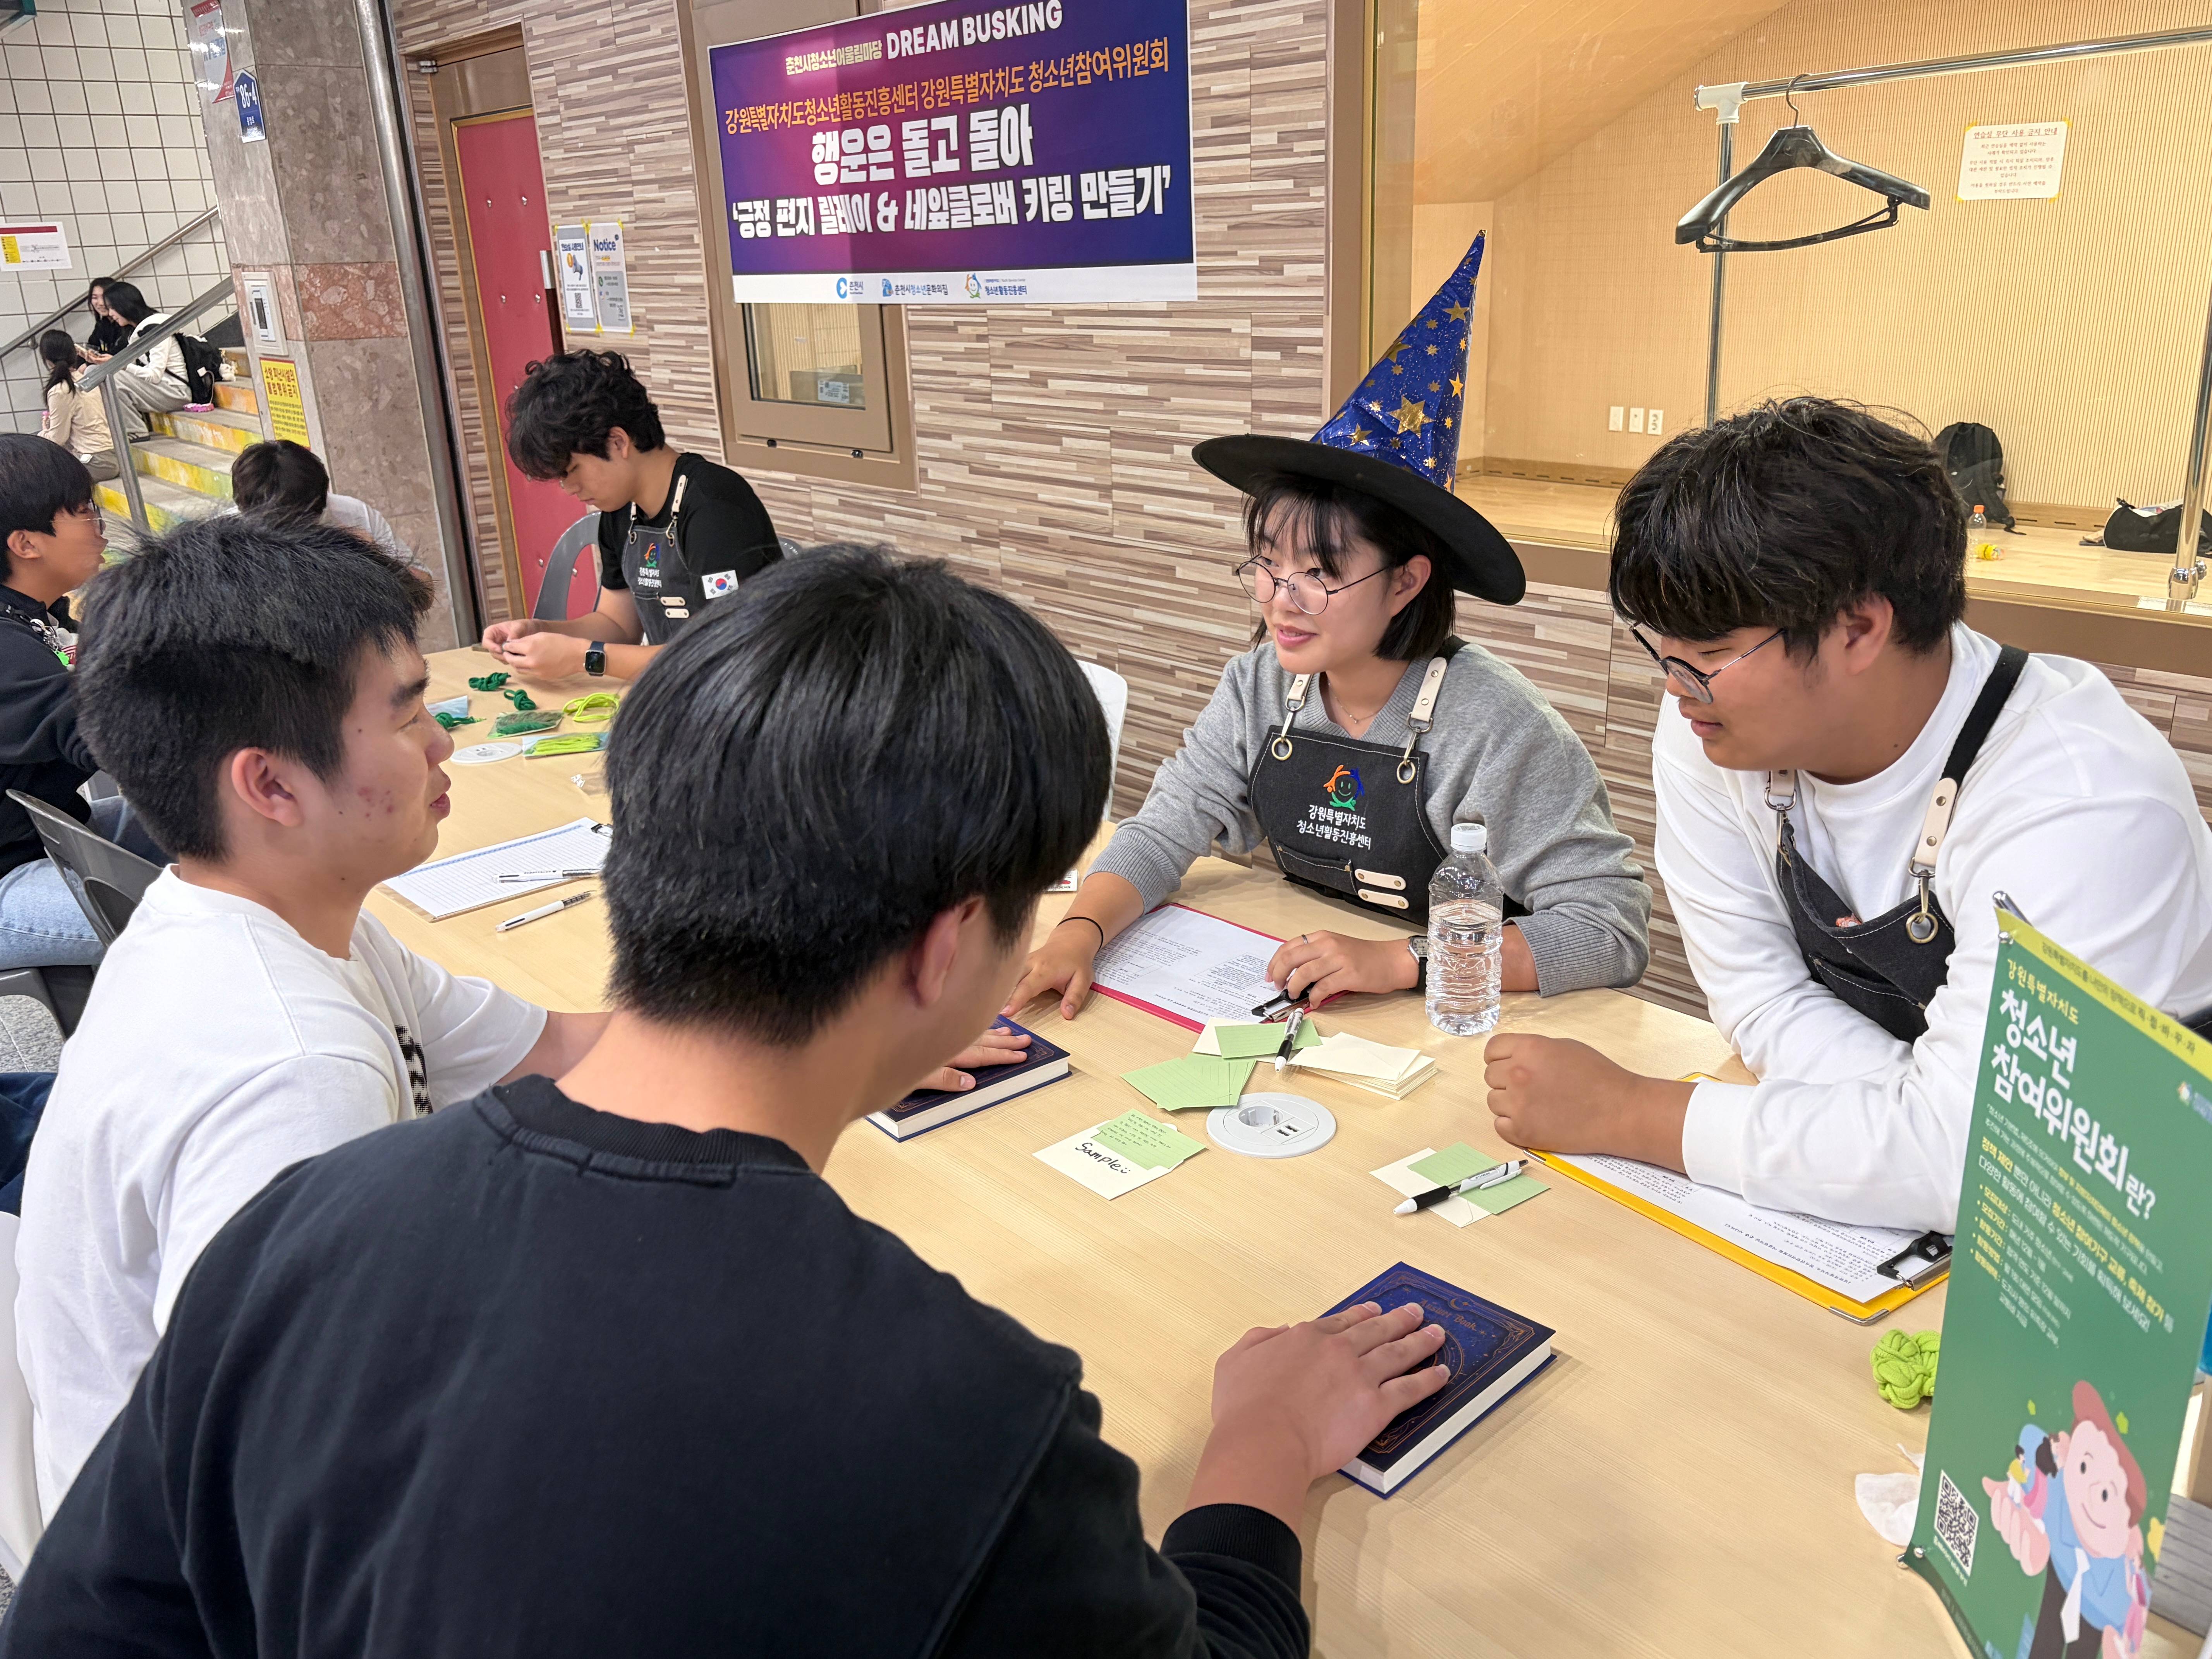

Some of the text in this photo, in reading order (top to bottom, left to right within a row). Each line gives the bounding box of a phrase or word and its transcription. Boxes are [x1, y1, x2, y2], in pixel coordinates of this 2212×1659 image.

[886, 19, 959, 59] DREAM
[963, 0, 1063, 46] BUSKING
[725, 37, 1169, 135] 강원특별자치도청소년활동진흥센터 강원특별자치도 청소년참여위원회
[812, 103, 1033, 185] 행운은 돌고 돌아
[776, 197, 815, 237] 편지
[818, 193, 872, 235] 릴레이
[877, 192, 898, 232] &
[1022, 174, 1073, 223] 키링
[593, 238, 617, 251] Notice
[1296, 819, 1371, 850] 청소년활동진흥센터
[1308, 804, 1366, 830] 강원특별자치도
[2008, 958, 2079, 1025] 강원특별자치도
[1999, 989, 2077, 1090] 청소년
[1075, 1142, 1121, 1171] Sample
[1991, 1044, 2156, 1220] 참여위원회란?
[1454, 1314, 1477, 1331] Book
